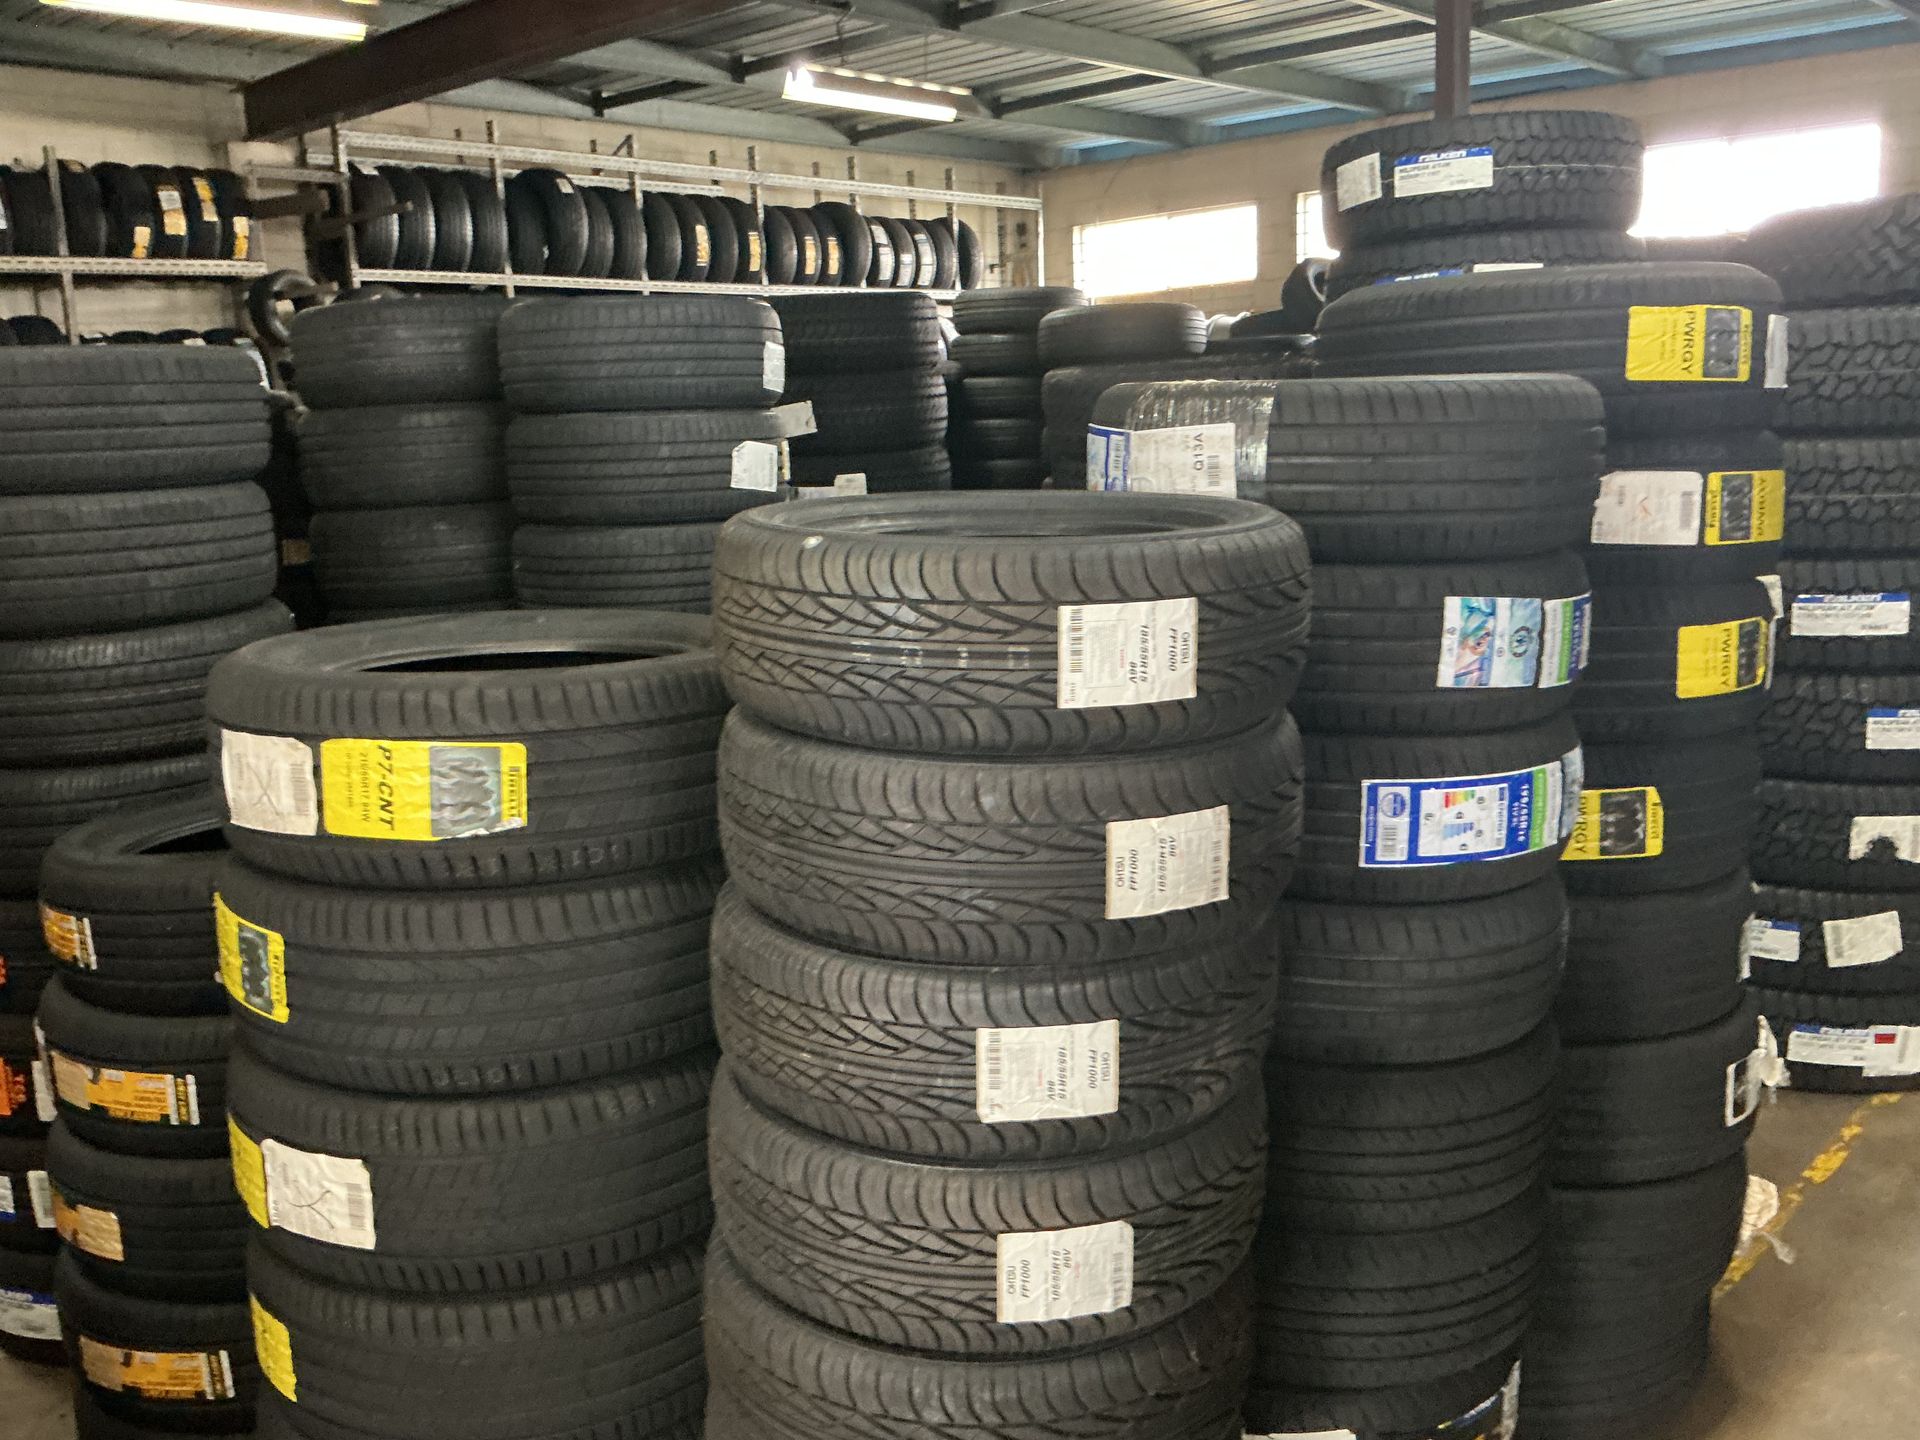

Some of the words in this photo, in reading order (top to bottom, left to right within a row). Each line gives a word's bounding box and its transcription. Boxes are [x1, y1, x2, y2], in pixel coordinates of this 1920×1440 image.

[1681, 310, 1697, 375] PWRGY
[1168, 627, 1178, 672] FP1000
[375, 744, 395, 831] P7-CNT
[1127, 848, 1139, 891] FP1000
[1088, 1049, 1098, 1089] FP1000
[1019, 1259, 1031, 1298] FP1000
